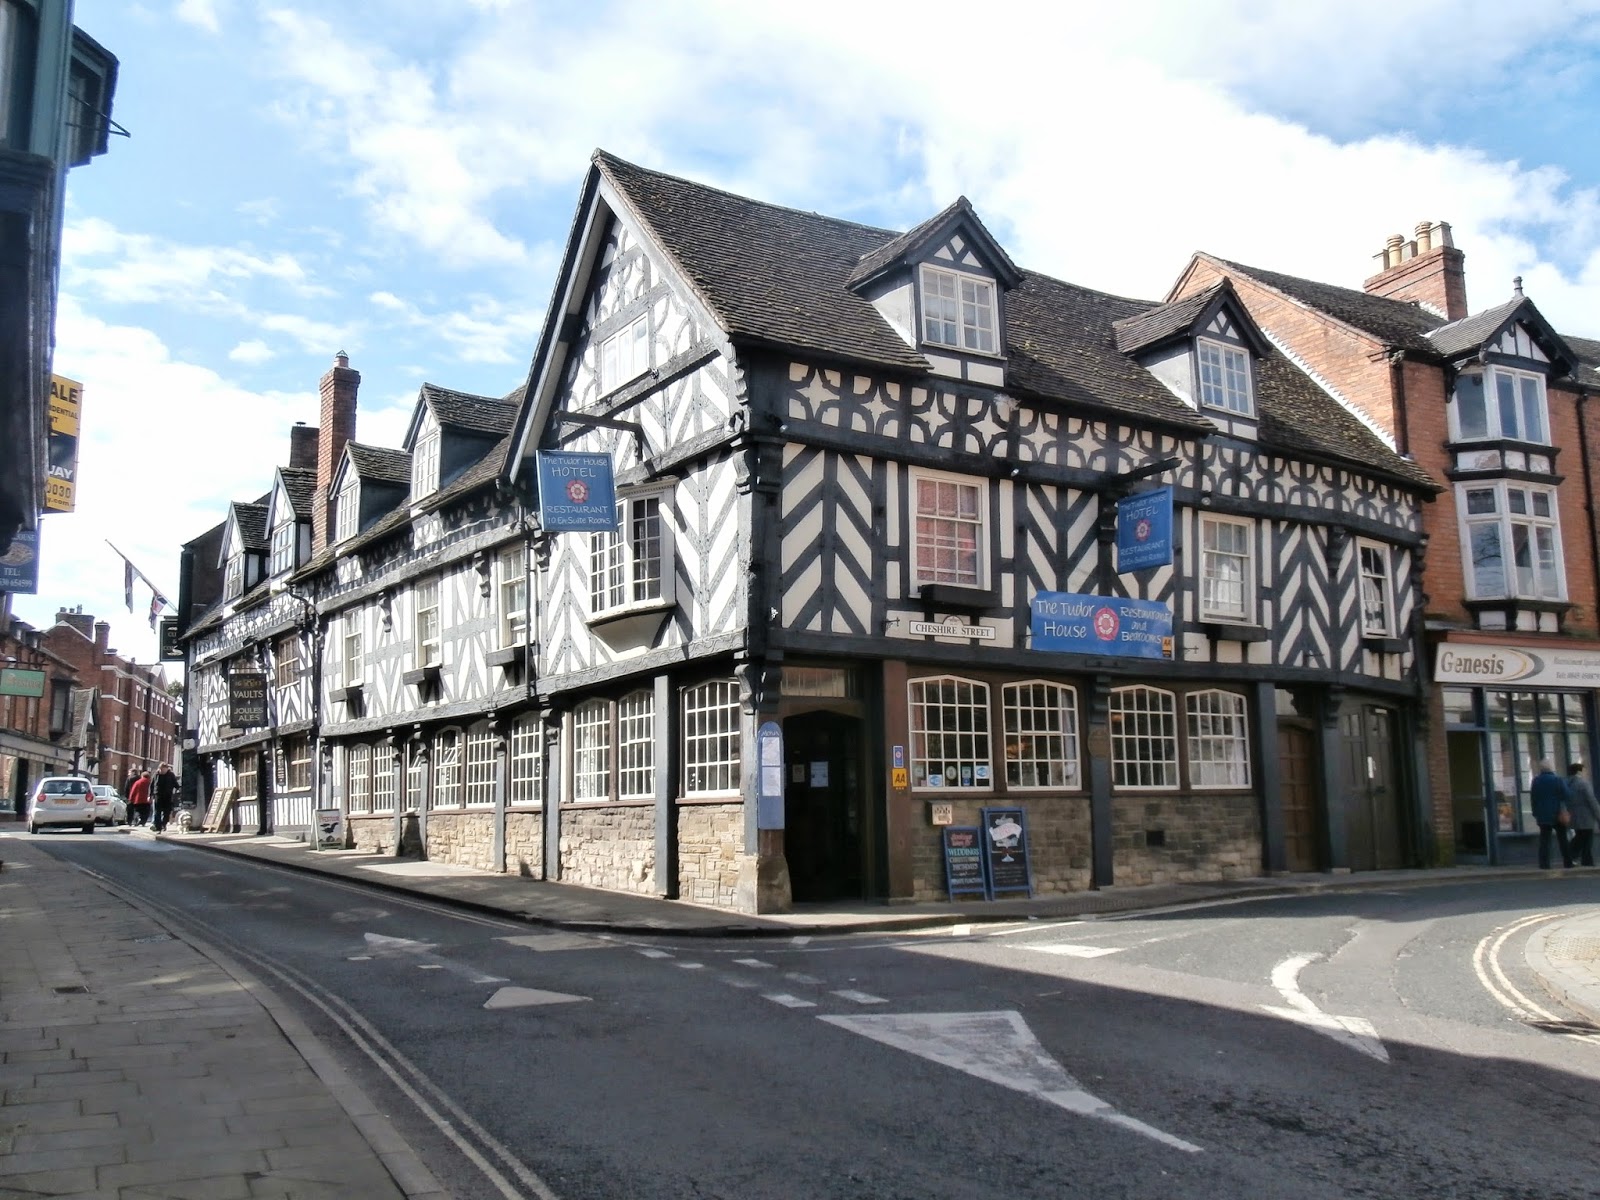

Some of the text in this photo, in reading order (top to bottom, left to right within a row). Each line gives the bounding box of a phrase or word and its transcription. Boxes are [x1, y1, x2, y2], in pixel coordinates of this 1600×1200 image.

[51, 381, 78, 404] ALE
[543, 456, 608, 466] The Tudor House
[551, 466, 597, 478] HOTEL
[47, 482, 71, 499] 0030
[47, 497, 70, 507] y.com
[546, 505, 608, 514] RESTAURANT
[1126, 505, 1159, 522] HOTEL
[557, 516, 567, 525] En
[567, 516, 587, 524] Suite
[587, 516, 611, 524] Rooms
[1120, 539, 1166, 556] RESTAURANT
[1036, 600, 1095, 617] The Tudor
[1120, 606, 1172, 622] Restaurant
[915, 623, 991, 637] CHESHIRE STREET
[1044, 621, 1087, 638] House
[1131, 621, 1148, 631] and
[1121, 631, 1162, 644] Bedrooms
[1440, 650, 1505, 675] Genesis
[233, 690, 264, 699] VAULTS
[233, 707, 264, 715] JOULES
[238, 714, 261, 722] ALES
[895, 773, 906, 783] AA
[948, 848, 980, 857] WEDDINGS
